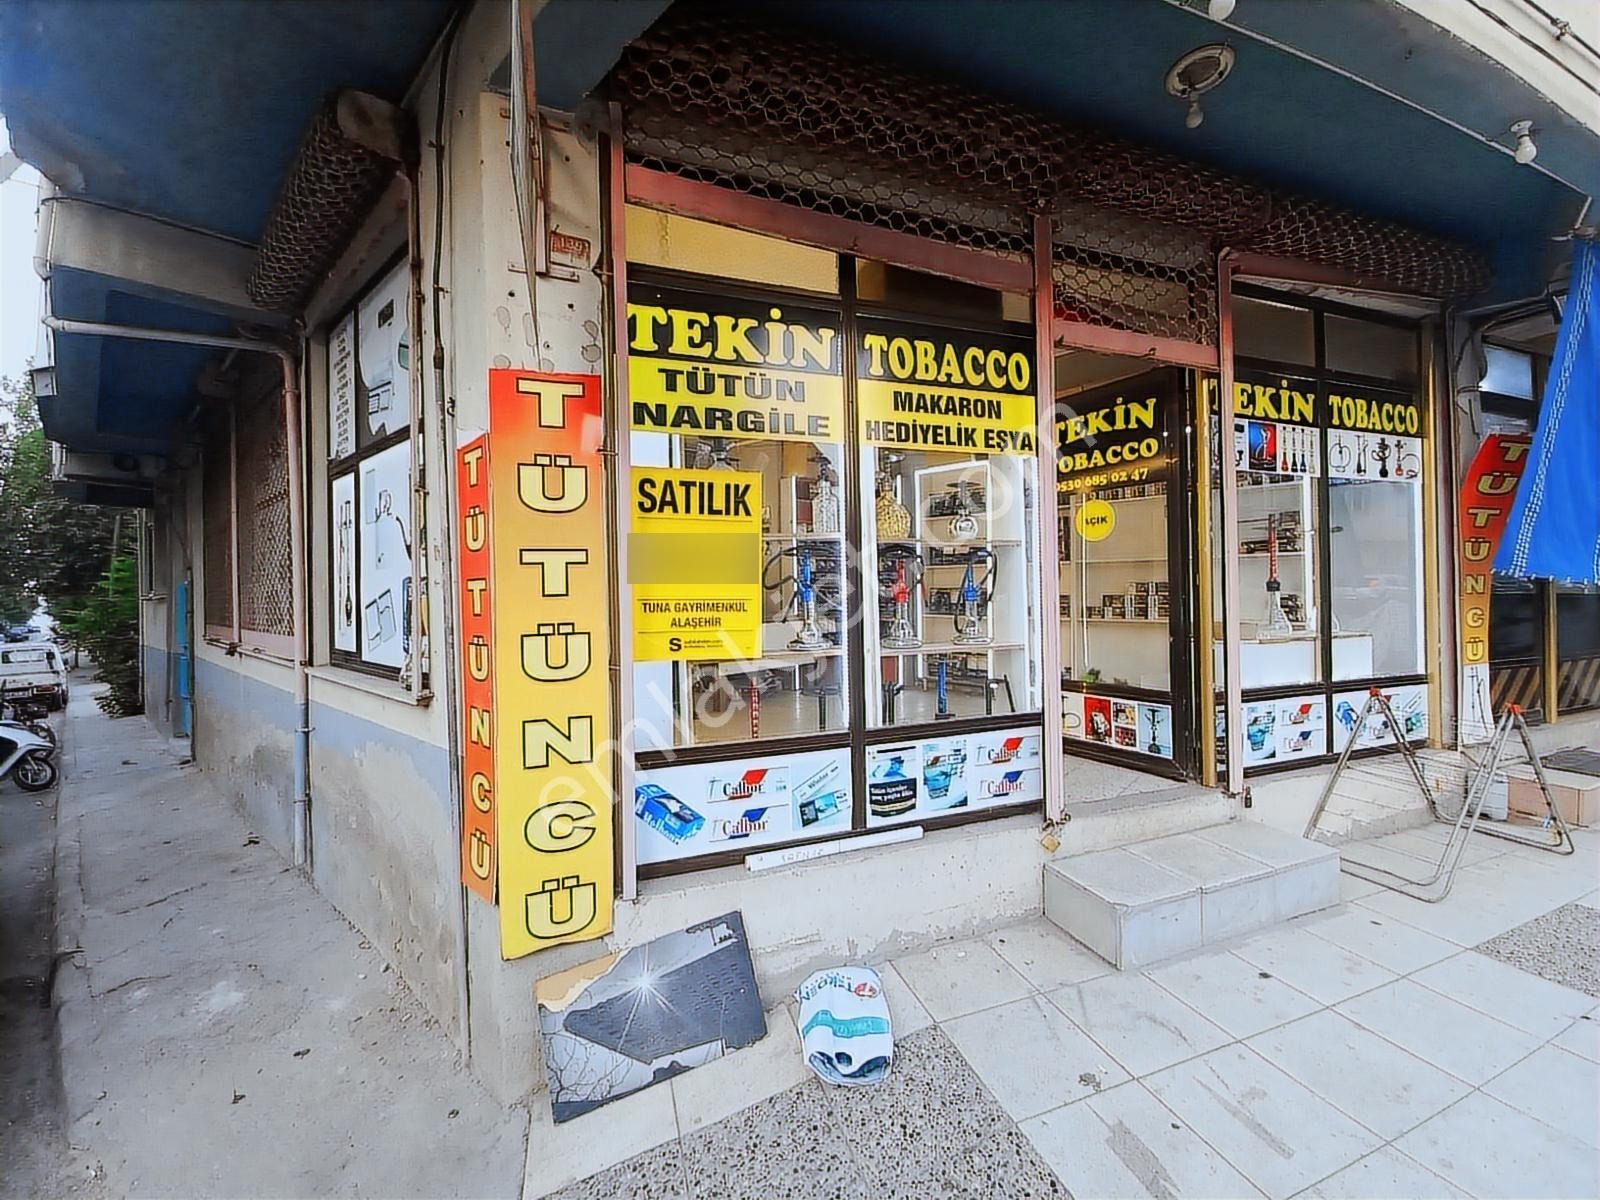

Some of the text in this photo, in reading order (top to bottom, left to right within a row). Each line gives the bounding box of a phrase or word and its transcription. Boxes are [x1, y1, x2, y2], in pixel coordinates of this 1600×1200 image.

[627, 302, 1030, 390] TEKİN TOBACCO
[658, 366, 805, 402] TÜTÜN
[633, 402, 830, 436] NARGİLE
[893, 391, 1002, 419] MAKARON
[1329, 395, 1419, 434] TOBACCO
[866, 419, 1033, 452] HEDİYELİK EŞYA
[1057, 438, 1159, 473] OBACCO
[1084, 474, 1107, 487] 685
[1111, 471, 1127, 482] 02
[1131, 467, 1148, 481] 47
[638, 478, 752, 517] SATILIK
[1463, 441, 1531, 662] TÜTÜNCÜ
[642, 600, 748, 613] TUNA GAYRİMENKUL
[671, 615, 721, 629] ALAŞEHİR
[463, 447, 492, 881] TÜTÜNCÜ
[516, 378, 597, 940] TÜTÜNCÜ
